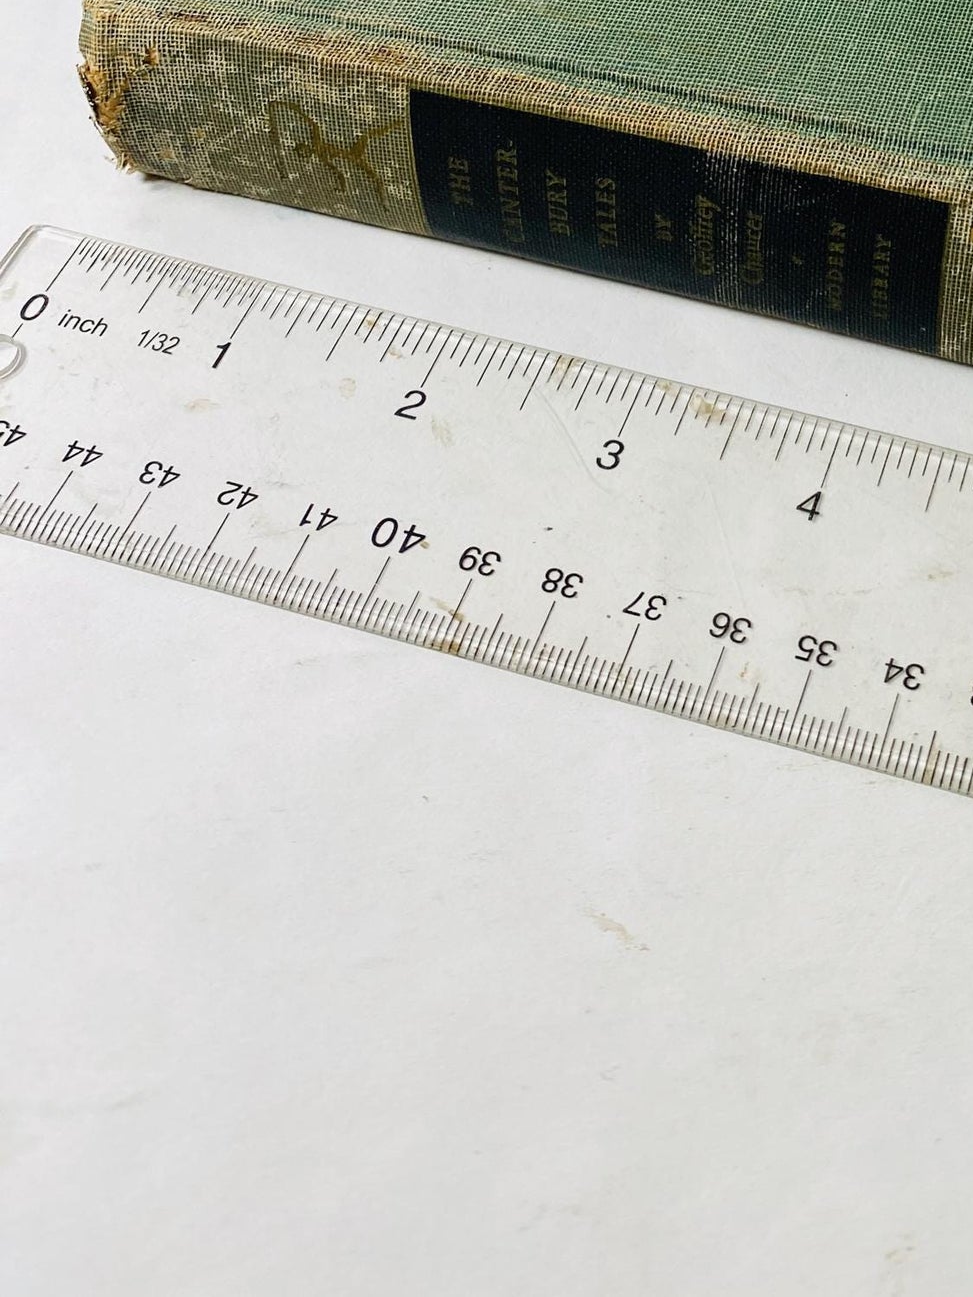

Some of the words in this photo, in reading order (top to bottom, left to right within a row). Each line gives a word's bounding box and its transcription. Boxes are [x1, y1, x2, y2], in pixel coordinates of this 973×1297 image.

[447, 154, 474, 207] THE
[545, 166, 573, 238] BURY
[19, 293, 50, 322] 0
[57, 312, 109, 338] inch
[137, 329, 181, 356] 1/32
[211, 341, 232, 370] 1
[393, 389, 427, 421] 2
[595, 439, 625, 471] 3
[795, 490, 824, 522] 4
[61, 439, 104, 468] 44
[138, 460, 182, 489] 43
[216, 480, 260, 510] 42
[298, 502, 339, 532] 41
[370, 517, 426, 554] 40
[458, 545, 502, 577] 39
[540, 567, 584, 599] 38
[621, 591, 668, 622] 37
[708, 611, 753, 645] 36
[794, 634, 839, 668] 35
[883, 657, 926, 692] 34
